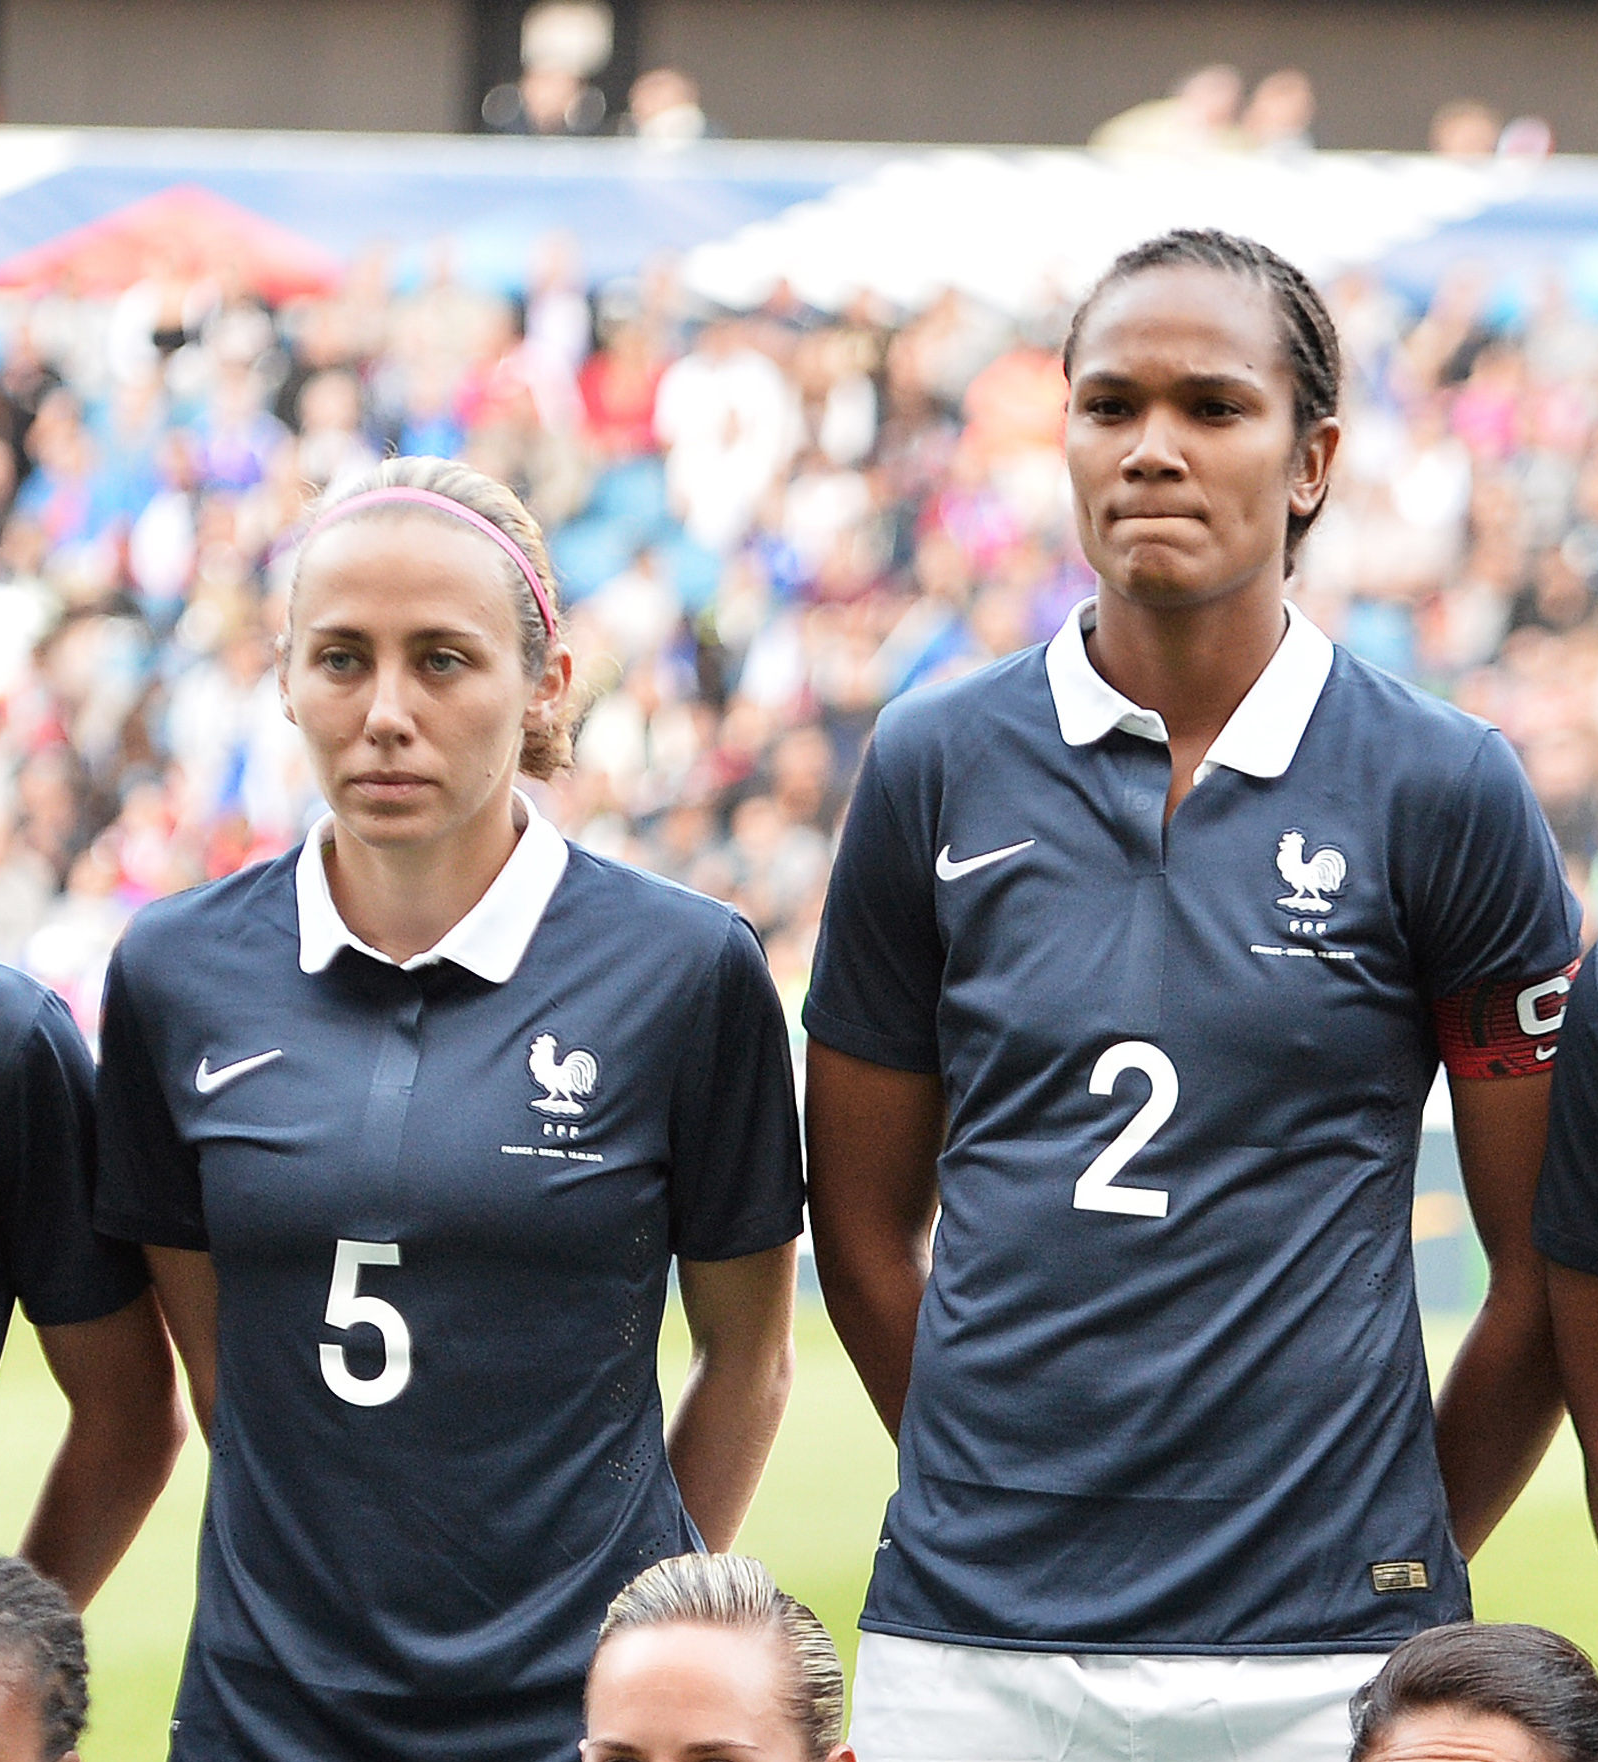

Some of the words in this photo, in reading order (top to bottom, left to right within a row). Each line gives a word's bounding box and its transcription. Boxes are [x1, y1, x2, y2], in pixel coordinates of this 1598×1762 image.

[1516, 974, 1571, 1036] C
[1073, 1040, 1180, 1219] 2
[318, 1238, 411, 1408] 5
